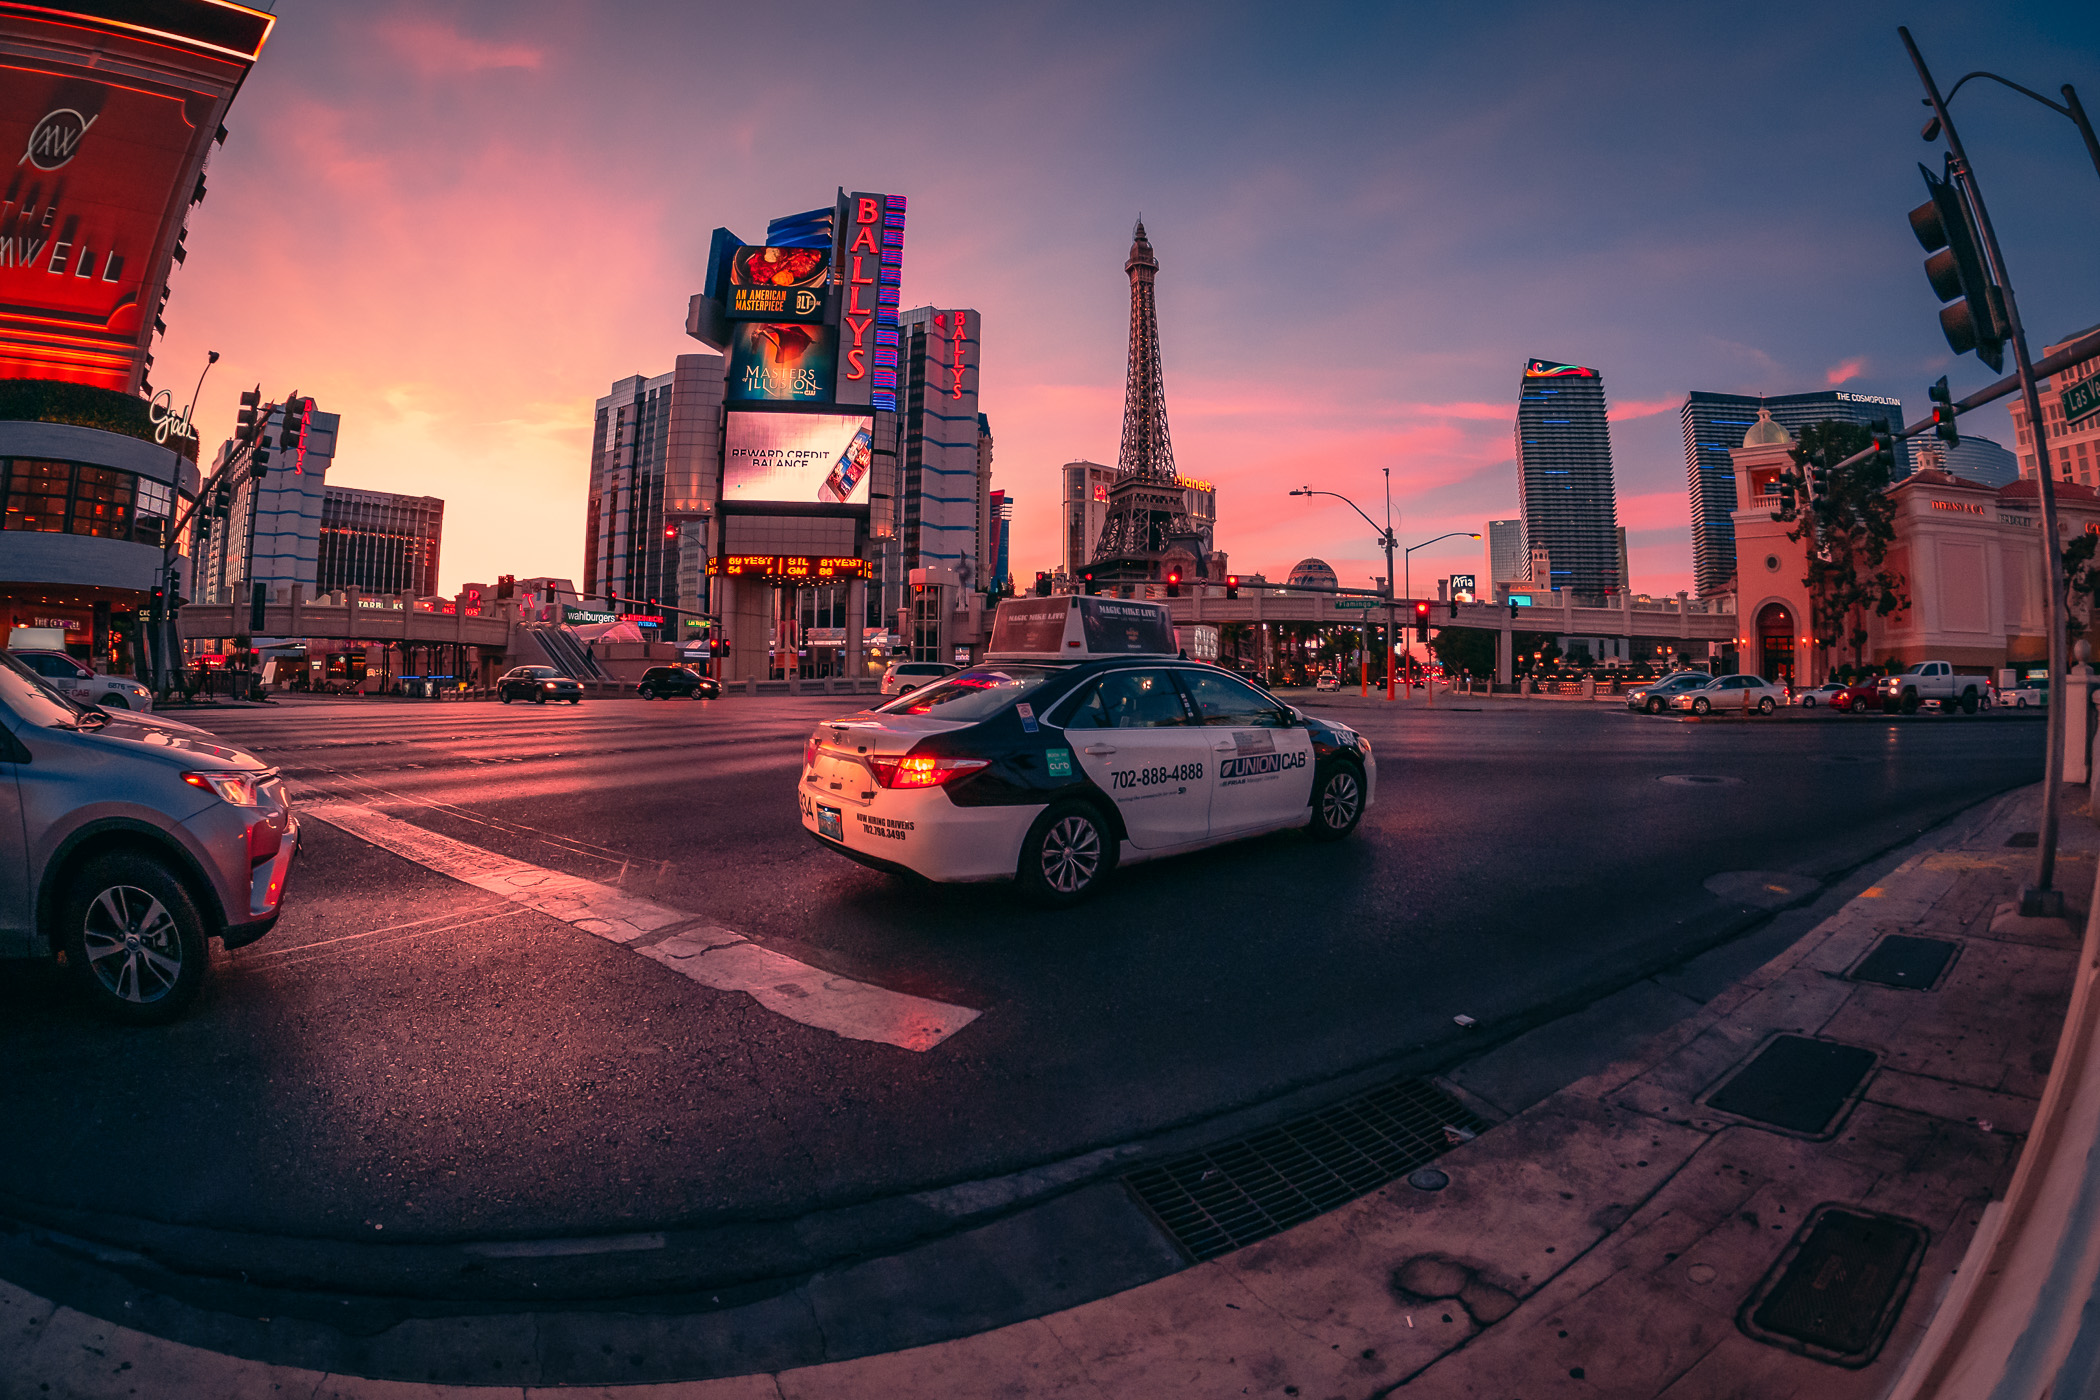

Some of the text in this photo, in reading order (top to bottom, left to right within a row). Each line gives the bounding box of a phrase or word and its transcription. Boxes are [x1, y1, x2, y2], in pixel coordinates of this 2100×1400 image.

[3, 201, 57, 227] THE
[736, 289, 787, 301] AN AMERICAN
[845, 198, 879, 380] BALLYS
[735, 300, 784, 312] MASTERPIECE
[796, 295, 811, 309] BLT
[951, 311, 967, 400] BALLYS
[746, 365, 816, 380] MASTERS
[748, 378, 817, 394] ILLUSION
[1836, 392, 1901, 406] THE COSMOPOLITAN
[2068, 389, 2088, 411] Las
[295, 399, 312, 476] BALLYS
[744, 557, 774, 565] YEST
[834, 559, 863, 567] YEST
[1453, 576, 1474, 588] Aria
[568, 611, 615, 624] wahlburgers
[1029, 613, 1047, 621] MIKE
[1048, 612, 1065, 620] LIVE
[1099, 605, 1157, 617] MAGIC MIKE LIVE
[72, 689, 90, 697] CAB
[1049, 762, 1070, 770] curb
[1235, 752, 1306, 776] UNION CAB
[1111, 763, 1203, 789] 702-888-4888
[887, 818, 915, 831] DRIVERS
